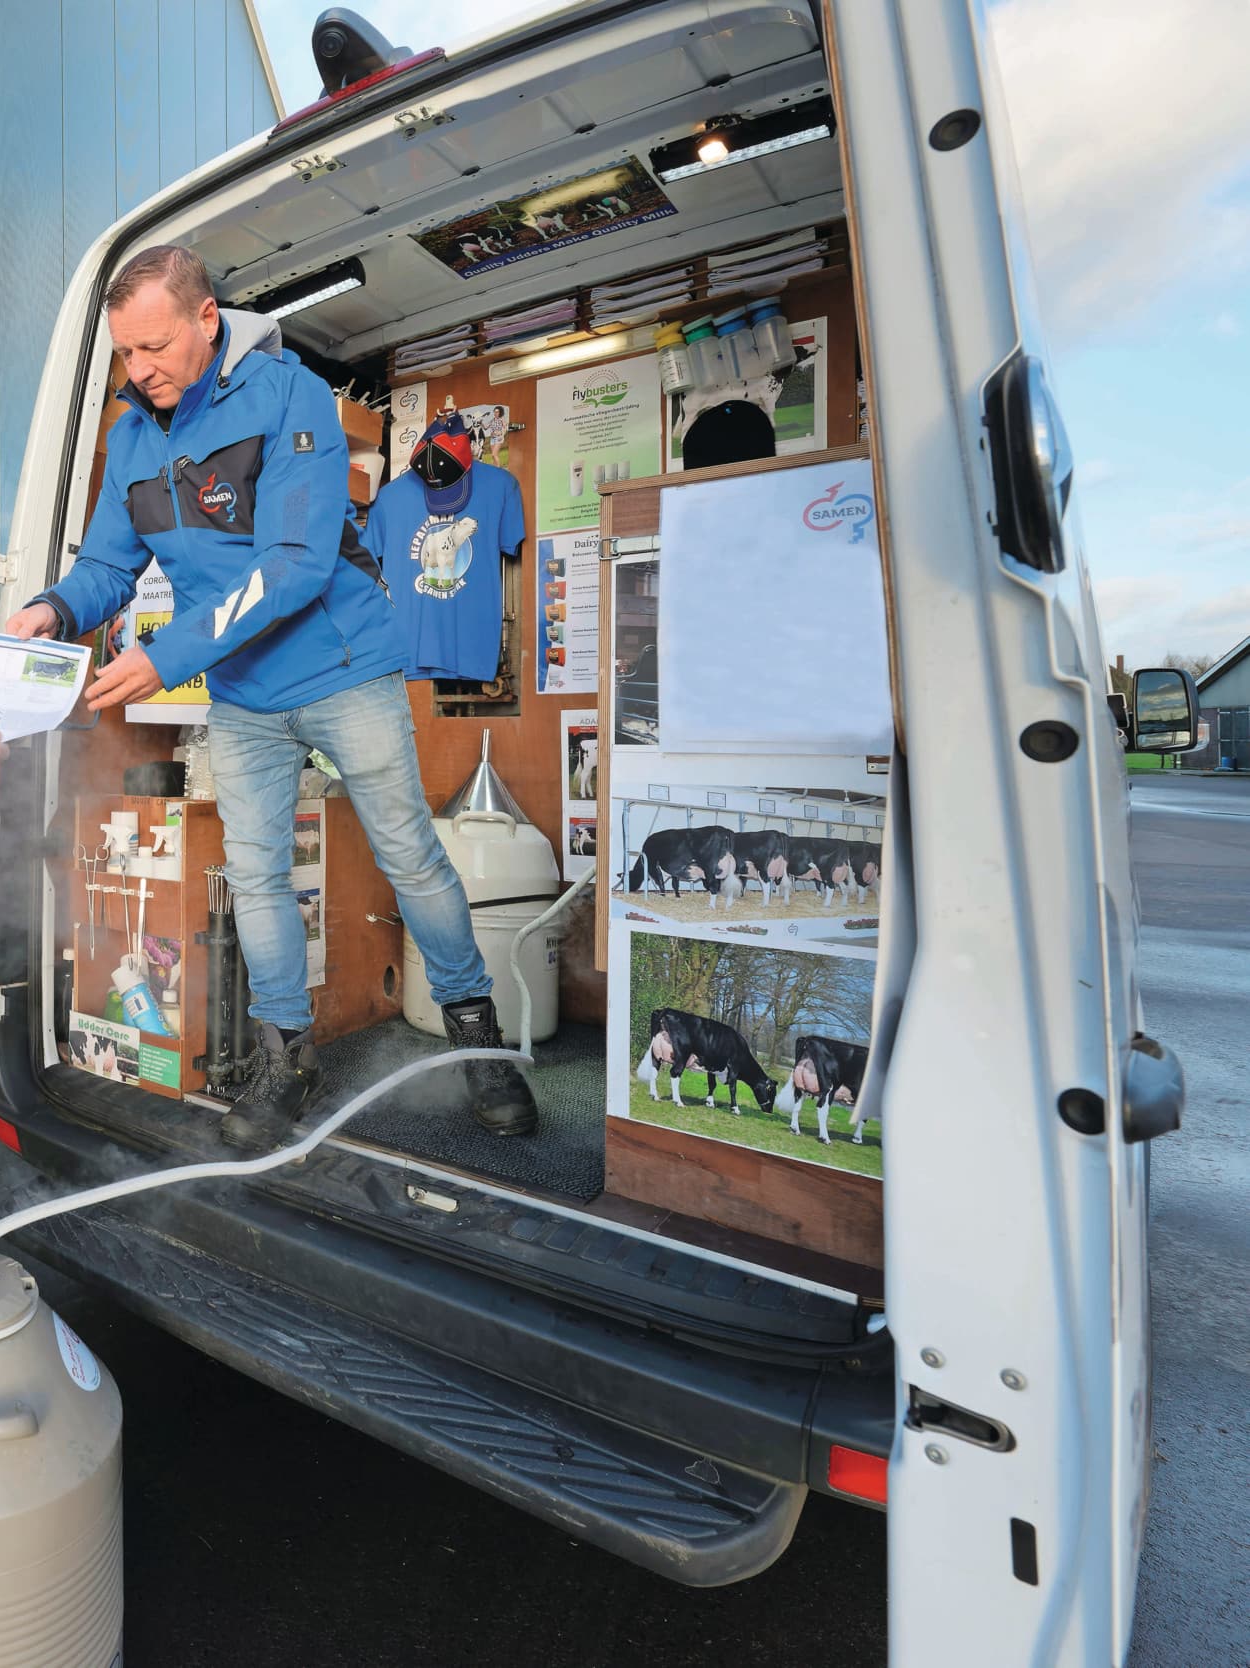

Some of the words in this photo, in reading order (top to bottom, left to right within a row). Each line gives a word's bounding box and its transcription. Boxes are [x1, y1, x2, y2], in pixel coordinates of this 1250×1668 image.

[464, 259, 505, 279] Quality
[507, 246, 551, 263] Udders
[552, 233, 590, 249] Make
[592, 219, 639, 237] Quality
[642, 208, 675, 222] Milk
[572, 381, 629, 401] flybusters
[203, 492, 233, 504] SAMEN
[812, 504, 867, 520] SAMEN
[574, 540, 600, 549] Dairy
[141, 622, 166, 635] HO
[77, 1017, 105, 1035] Udder
[106, 1026, 130, 1042] Care
